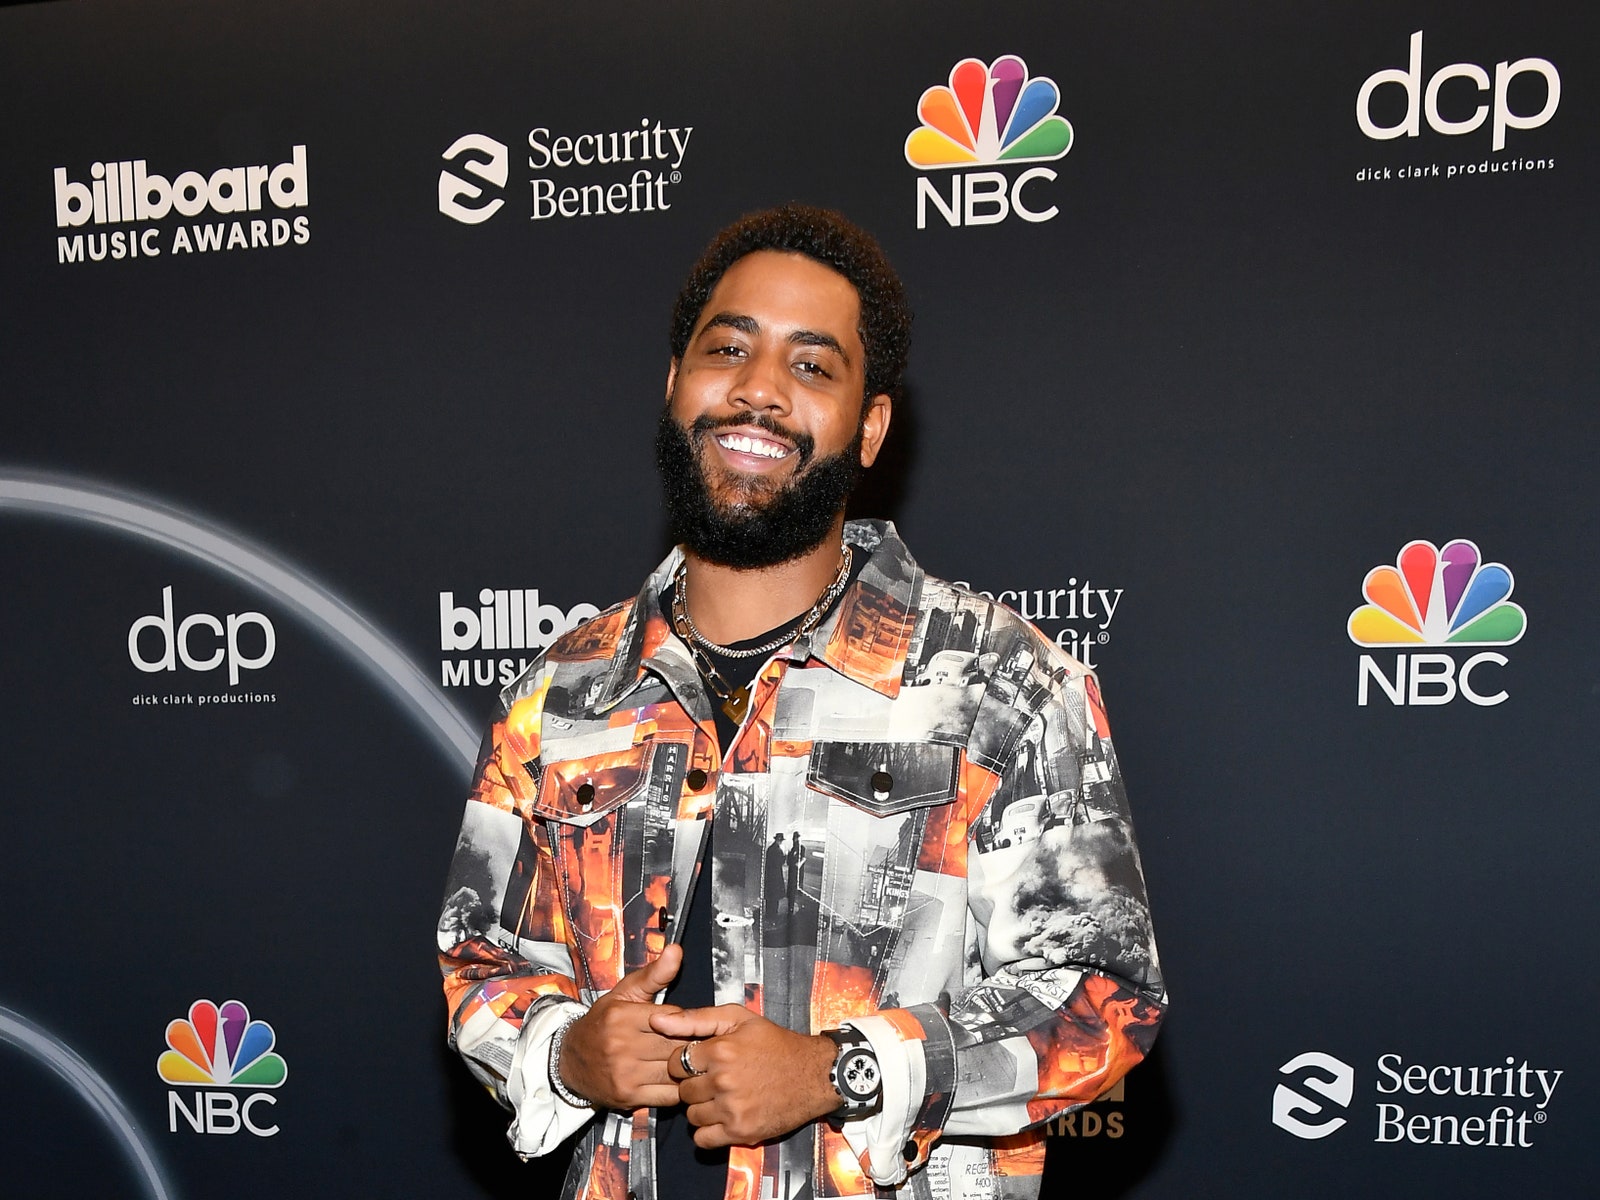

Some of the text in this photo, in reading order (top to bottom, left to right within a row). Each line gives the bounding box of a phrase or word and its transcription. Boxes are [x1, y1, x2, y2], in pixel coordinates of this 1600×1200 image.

[1357, 30, 1560, 151] dcp
[529, 118, 693, 168] Security
[1357, 158, 1554, 180] dick clark productions
[54, 145, 308, 227] billboard
[917, 168, 1059, 229] NBC
[58, 216, 309, 263] MUSIC AWARDS
[127, 585, 276, 686] dcp
[440, 588, 601, 651] billbo
[133, 692, 276, 705] dick clark productions
[1358, 652, 1509, 706] NBC
[662, 746, 677, 803] HARRIS
[1377, 1054, 1563, 1108] Security
[169, 1091, 279, 1136] NBC
